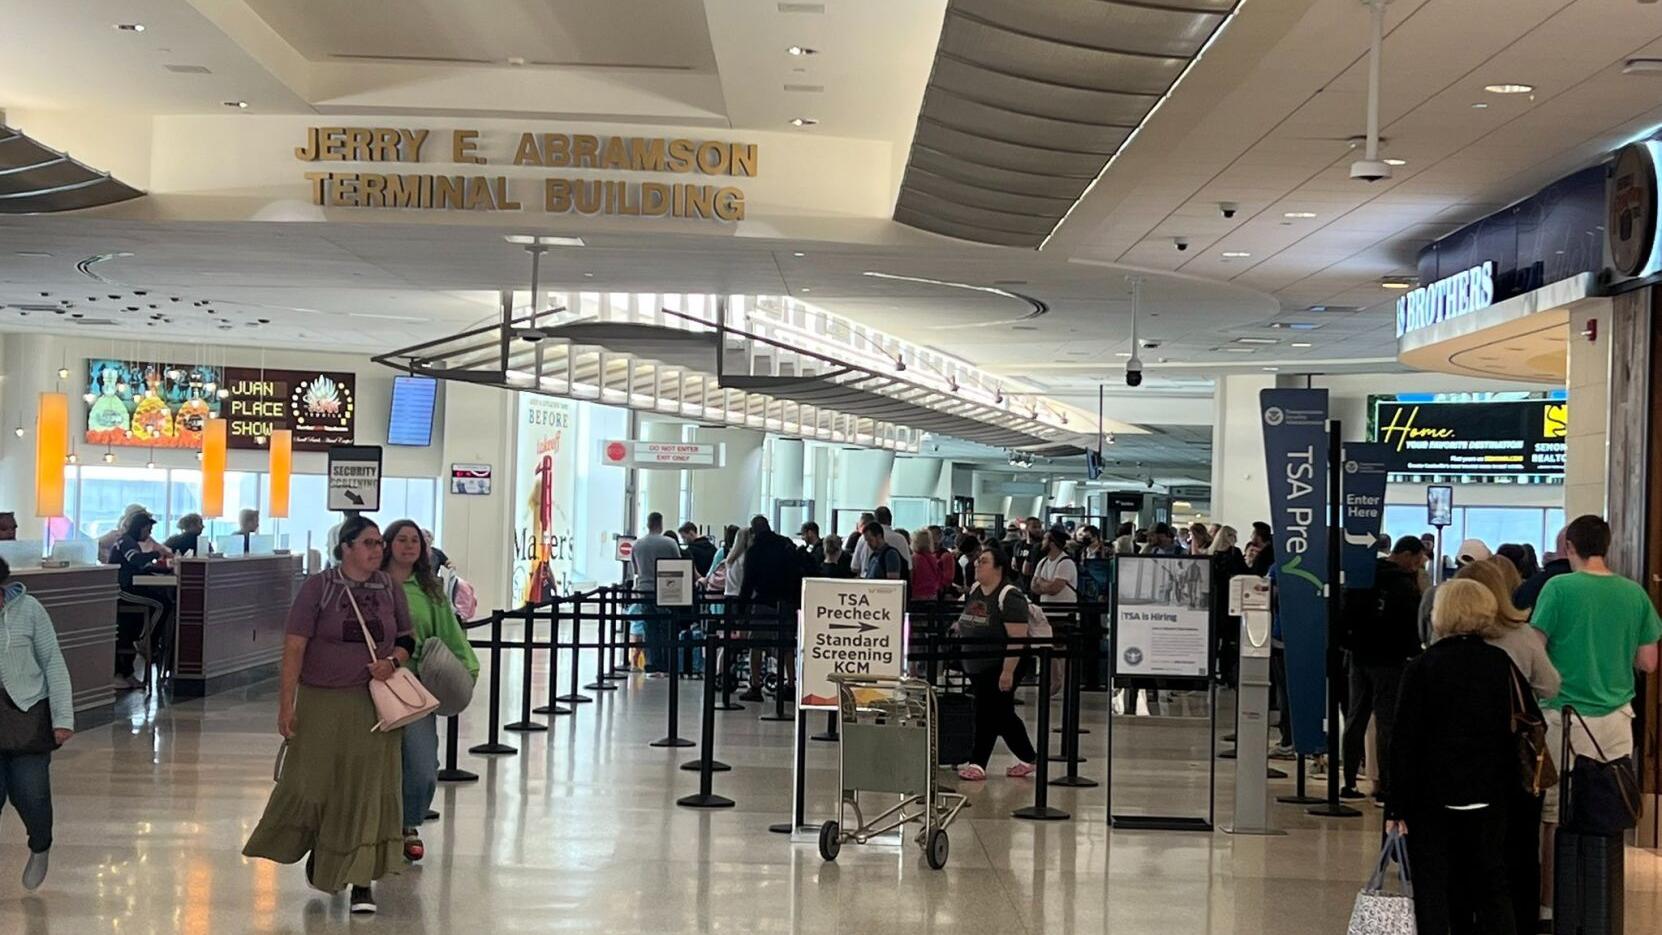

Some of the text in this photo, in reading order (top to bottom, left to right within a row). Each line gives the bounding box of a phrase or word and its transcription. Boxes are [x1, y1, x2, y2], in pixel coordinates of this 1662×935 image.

[295, 127, 758, 178] JERRY E. ABRAMSON
[304, 171, 746, 221] TERMINAL BUILDING
[1406, 261, 1494, 334] BROTHERS
[231, 381, 274, 396] JUAN
[231, 401, 284, 416] PLACE
[529, 409, 569, 428] BEFORE
[231, 421, 273, 436] SHOW
[1381, 406, 1455, 452] Home.
[333, 465, 377, 477] SECURITY
[1286, 445, 1313, 499] TSA
[1346, 494, 1380, 506] Enter
[1348, 506, 1378, 518] Here
[1286, 507, 1313, 554] Pre
[513, 528, 574, 560] Maer's
[838, 593, 870, 606] TSA
[817, 606, 891, 621] Precheck
[1124, 612, 1177, 622] TSA is Hiring
[816, 633, 889, 648] Standard
[812, 647, 892, 664] Screening
[834, 661, 870, 675] KCM
